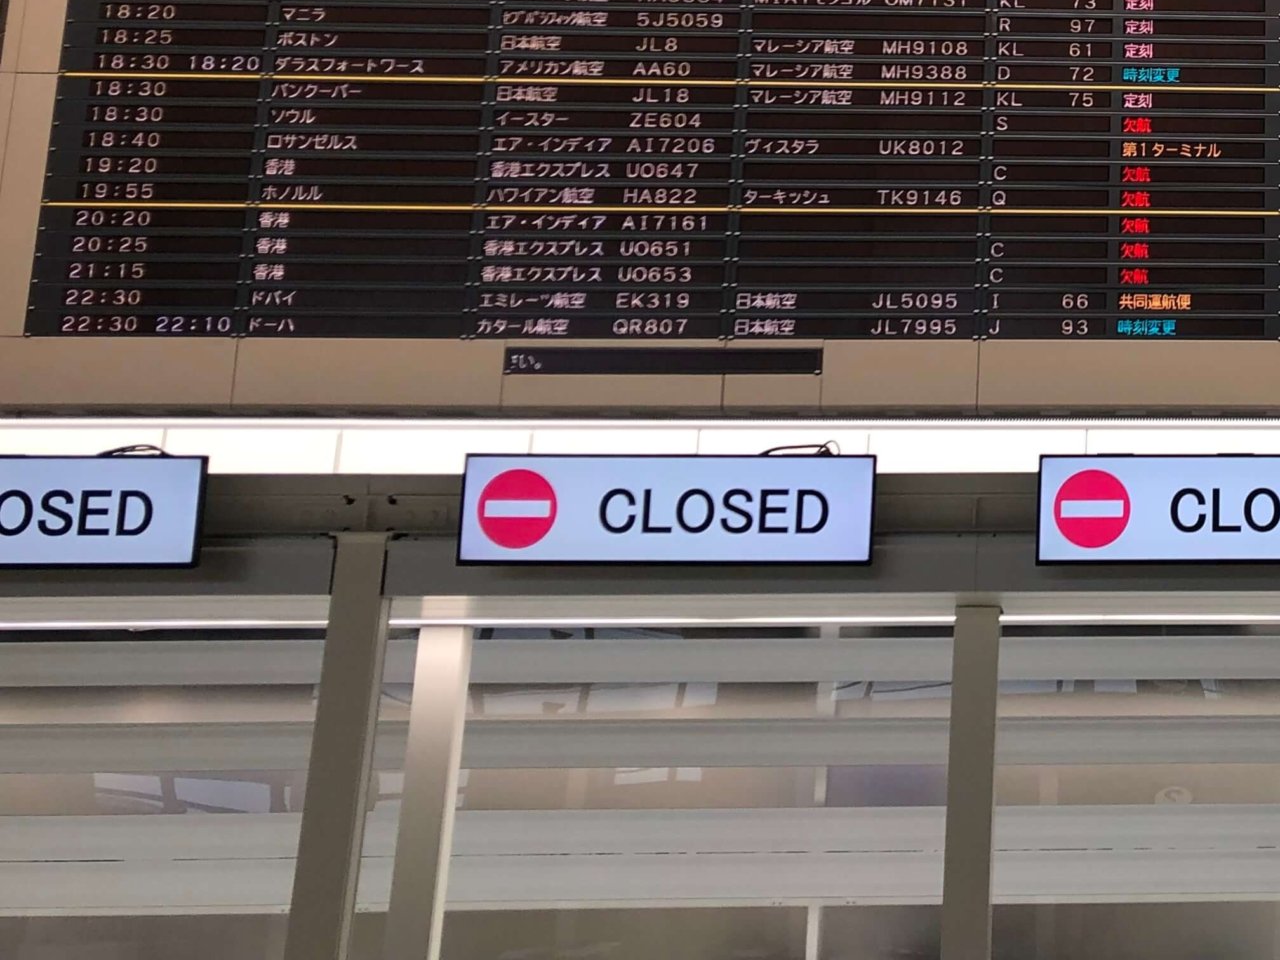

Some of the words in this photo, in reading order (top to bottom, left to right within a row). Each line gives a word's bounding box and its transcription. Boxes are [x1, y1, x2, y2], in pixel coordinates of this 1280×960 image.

[98, 54, 169, 70] 18:30
[189, 55, 260, 71] 18:20
[275, 57, 425, 74] ダラスフォートワース
[500, 60, 605, 76] アメリカン航空
[632, 61, 691, 77] AA60
[751, 64, 854, 80] マレーシア航空
[881, 64, 967, 80] MH9388
[997, 66, 1011, 81] D
[1069, 66, 1094, 82] 72
[1122, 67, 1181, 83] 時刻変更
[81, 183, 154, 199] 19:55
[261, 185, 323, 201] ホノルル
[486, 188, 595, 204] ハワイアン航空
[623, 188, 697, 205] HA822
[743, 189, 831, 205] ターキッシュ
[877, 189, 962, 206] TK9146
[992, 190, 1007, 206] Q
[1121, 192, 1151, 208] 欠航
[61, 315, 138, 332] 22:30
[155, 316, 231, 332] 22:10
[248, 317, 295, 332] ドーハ
[476, 318, 570, 336] カタール航空
[612, 318, 688, 335] QR807
[733, 319, 797, 336] 日本航空
[870, 319, 957, 336] JL7995
[988, 319, 1001, 335] J
[1061, 319, 1089, 335] 93
[1117, 319, 1177, 336] 時刻変更
[599, 488, 830, 535] CLOSED
